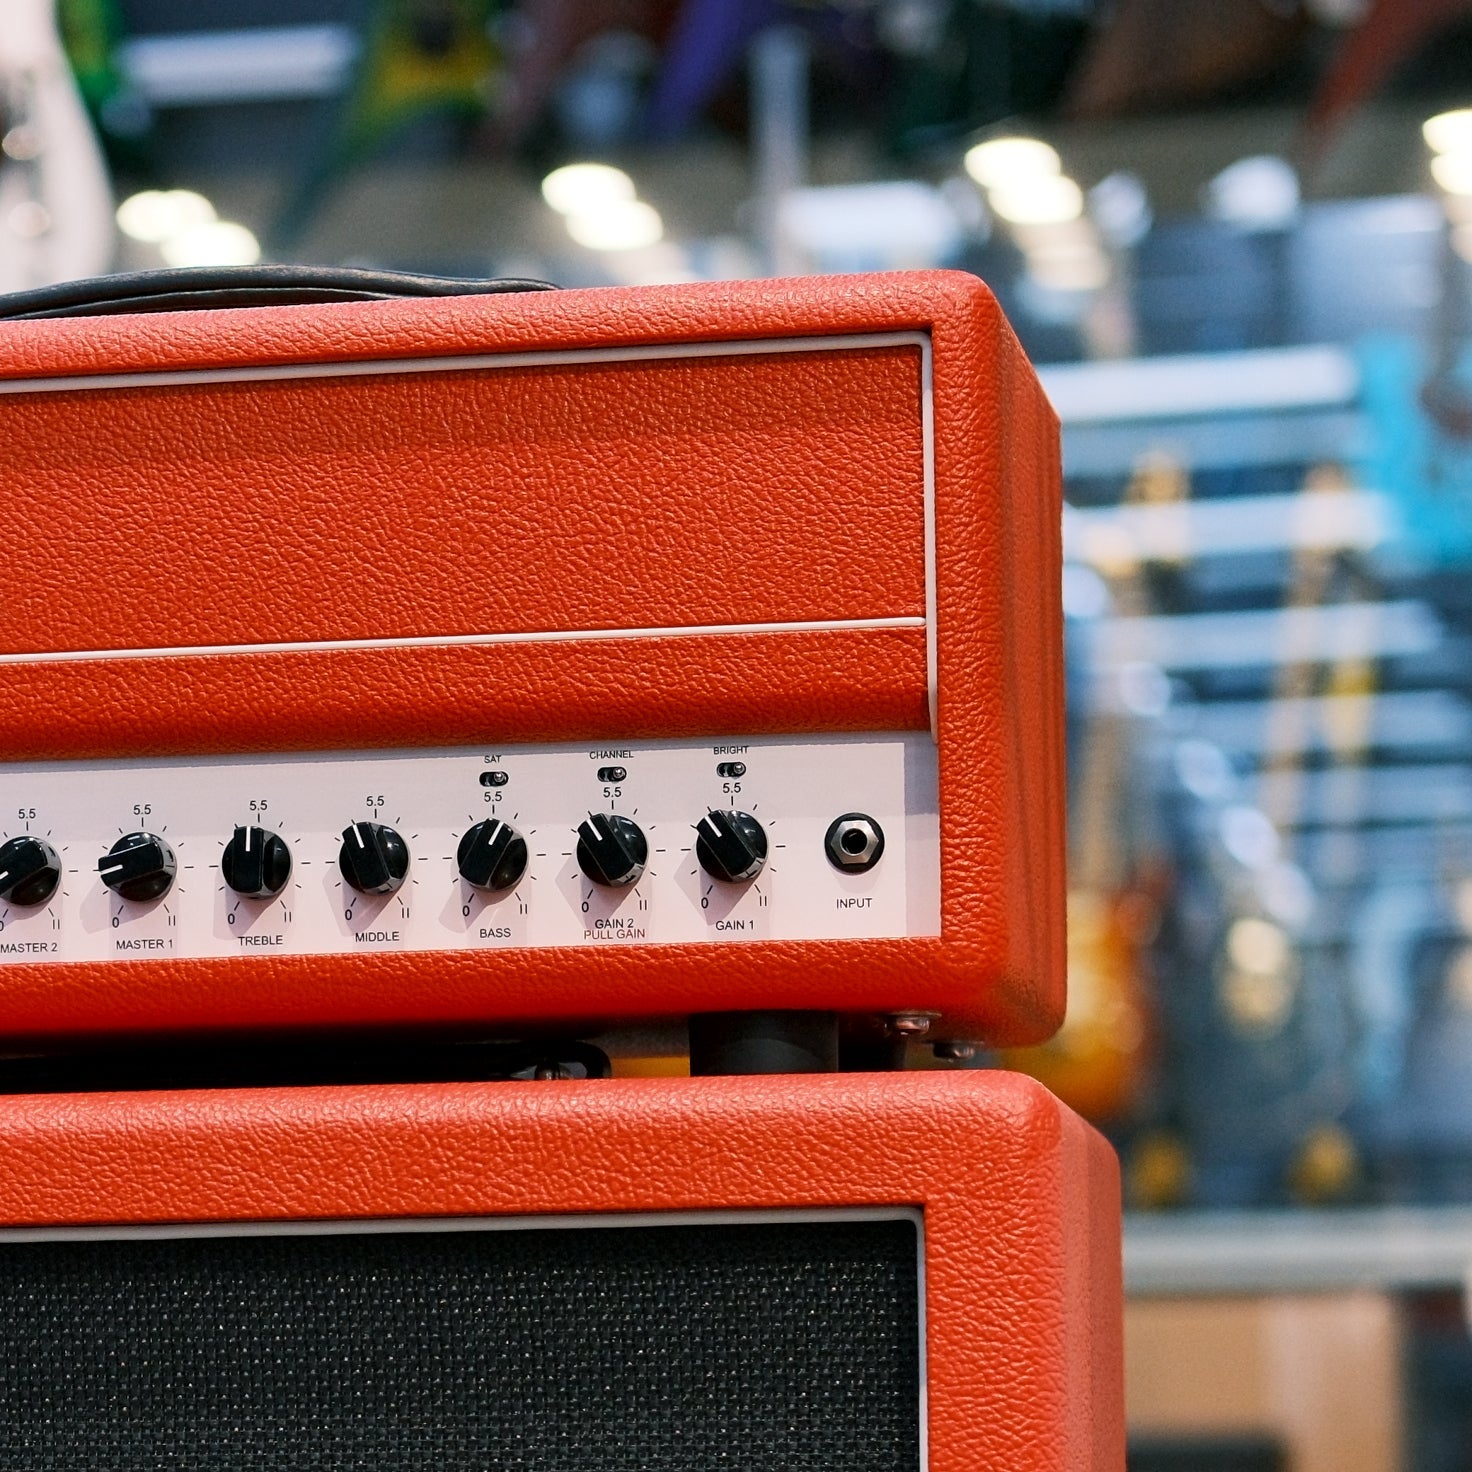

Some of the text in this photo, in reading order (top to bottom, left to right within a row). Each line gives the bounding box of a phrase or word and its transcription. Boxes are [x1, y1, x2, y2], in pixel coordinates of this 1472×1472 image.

[589, 750, 634, 760] CHANNEL
[713, 745, 750, 756] BRIGHT
[483, 755, 502, 764] SAT
[603, 786, 622, 798] 5.5
[722, 782, 742, 794] 5.5
[366, 795, 385, 807] 5.5
[483, 790, 503, 803] 5.5
[133, 803, 152, 816] 5.5
[249, 799, 268, 811] 5.5
[18, 808, 36, 820] 5.5
[581, 900, 590, 913] 0
[700, 896, 710, 910] 0
[836, 897, 873, 909] INPUT
[344, 908, 353, 921] 0
[462, 904, 471, 918] 0
[111, 915, 121, 929] 0
[227, 912, 237, 926] 0
[593, 918, 625, 930] GAIN
[715, 919, 745, 931] GAIN
[354, 931, 400, 943] MIDDLE
[479, 927, 512, 939] BASS
[583, 929, 646, 940] PULL GAIN
[116, 938, 165, 950] MASTER
[237, 934, 284, 946] TREBLE
[0, 942, 48, 954] MASTER
